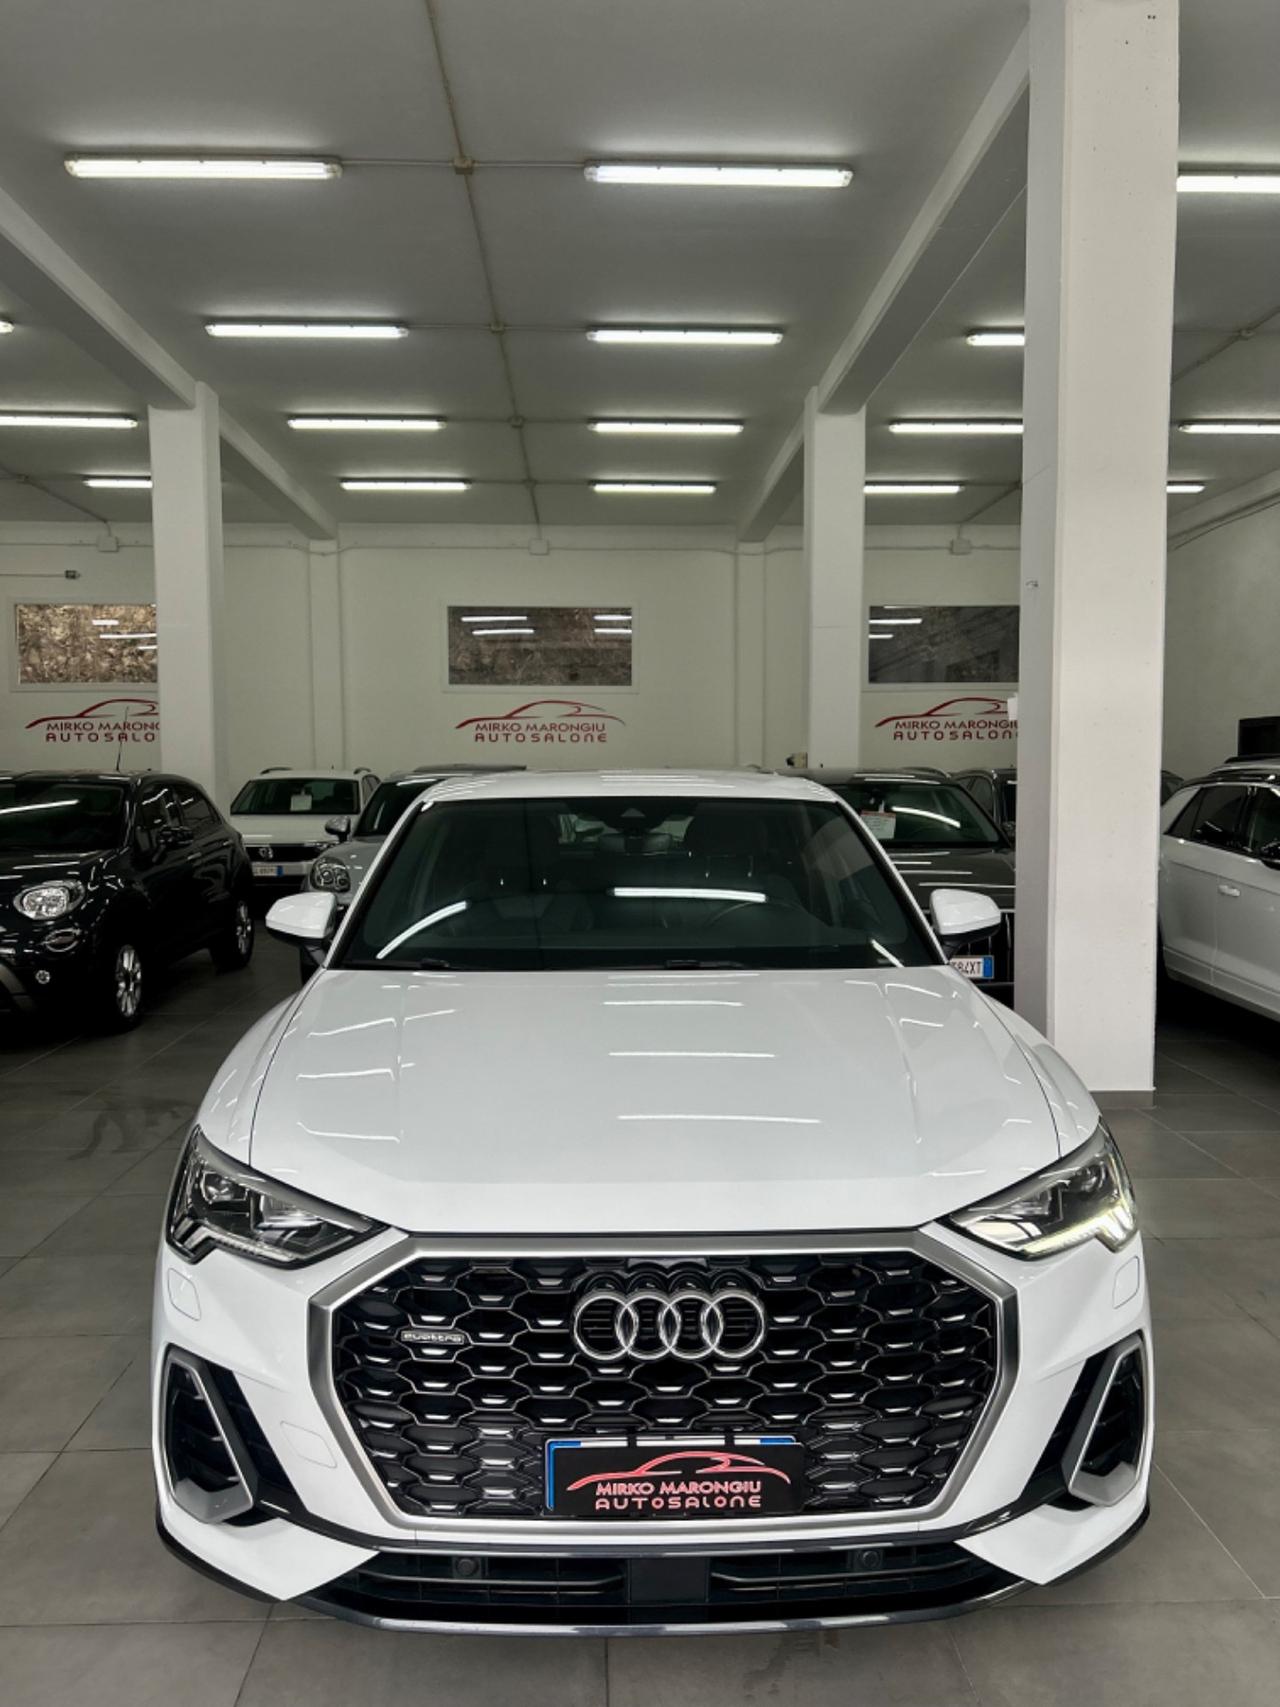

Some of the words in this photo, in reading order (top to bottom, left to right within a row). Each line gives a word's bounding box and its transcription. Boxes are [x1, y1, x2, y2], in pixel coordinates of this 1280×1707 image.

[47, 722, 94, 731] MIRKO
[475, 722, 521, 732] MIRKO
[526, 722, 606, 732] MARONGIU
[895, 720, 940, 729] MIRKO
[46, 733, 155, 742] AUTOSALO
[475, 733, 607, 742] AUTOSALONE
[894, 730, 1018, 740] AUTOSALON
[596, 1482, 655, 1496] MIRKO
[660, 1481, 761, 1495] MARONGIU
[595, 1496, 761, 1510] AUTOSALONE
